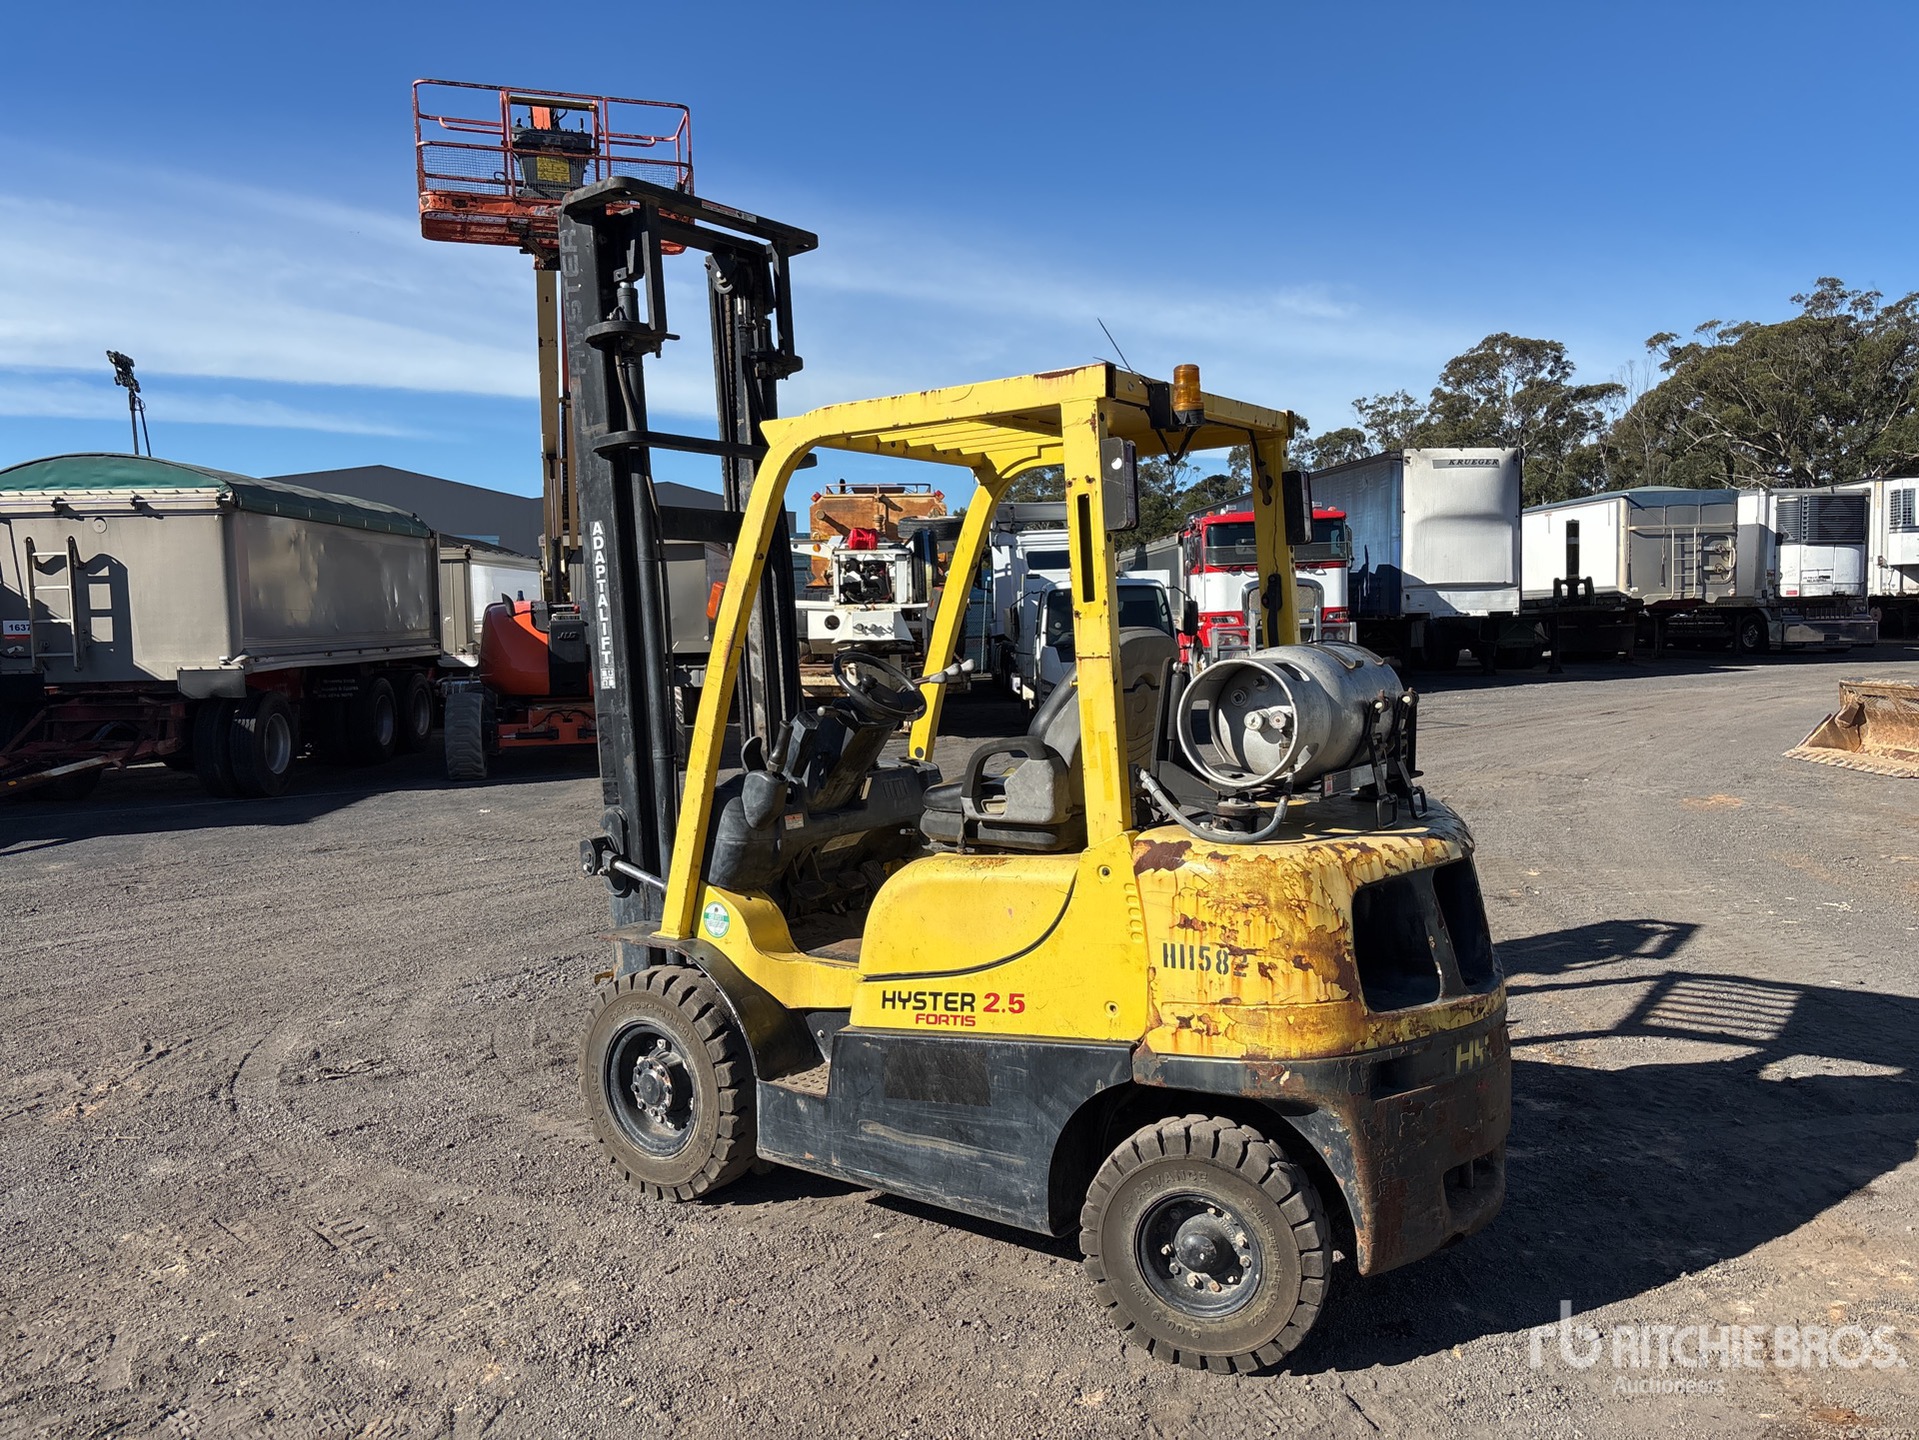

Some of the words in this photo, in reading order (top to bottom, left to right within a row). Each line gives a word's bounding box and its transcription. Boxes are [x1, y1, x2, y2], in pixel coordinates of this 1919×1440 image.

[559, 229, 586, 375] HYSTER
[592, 521, 612, 665] ADAPTALIFT
[881, 990, 977, 1012] HYSTER
[983, 992, 1026, 1014] 2.5
[915, 1013, 977, 1027] FORTIS
[1132, 1169, 1209, 1201] ADVANCE
